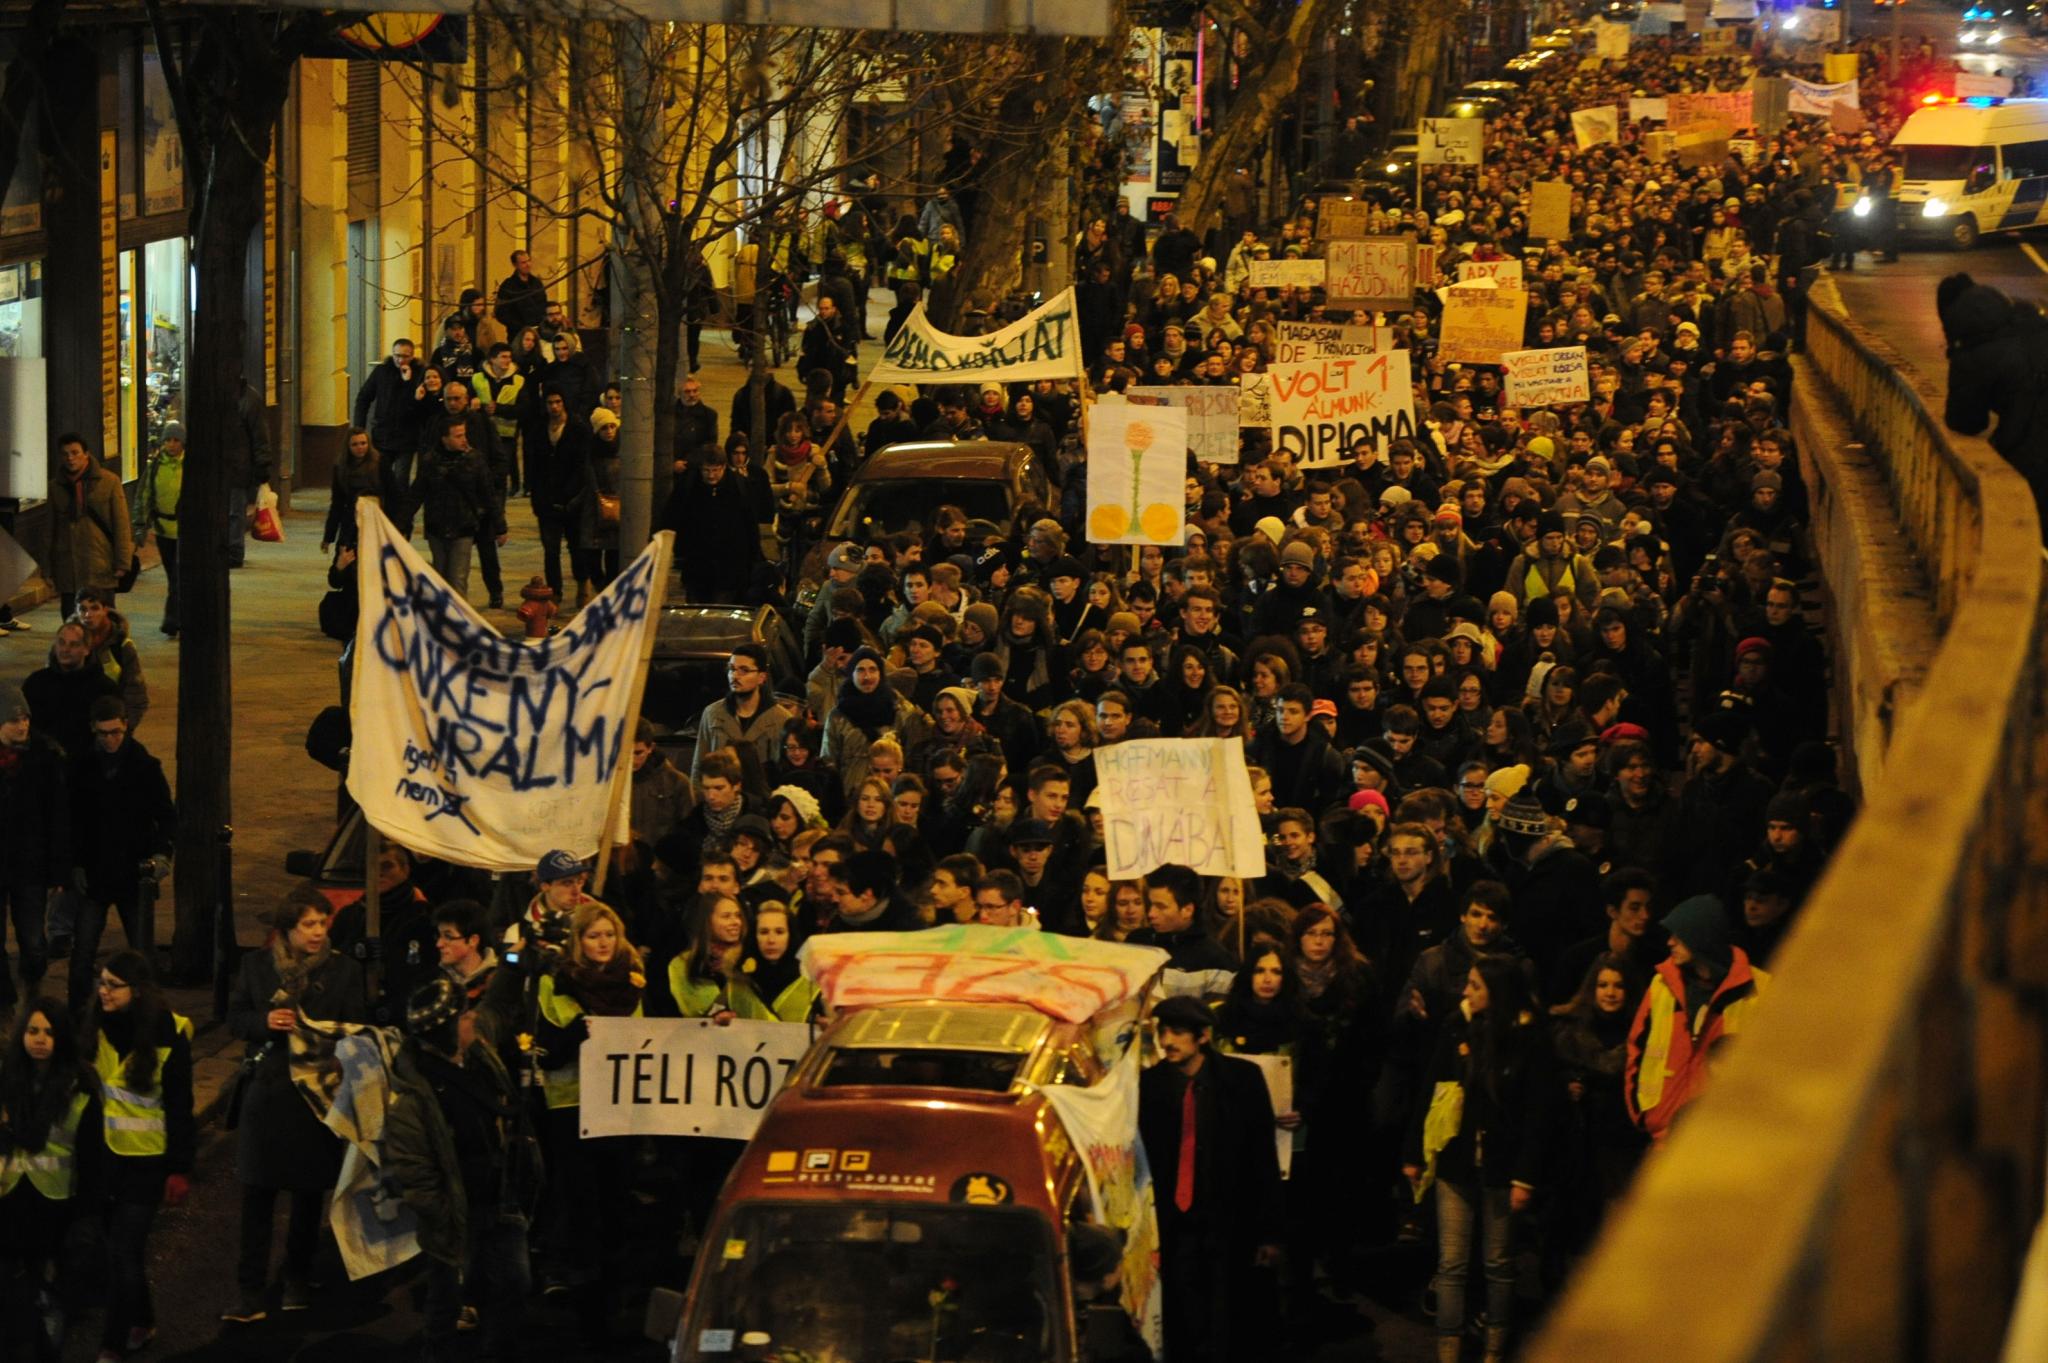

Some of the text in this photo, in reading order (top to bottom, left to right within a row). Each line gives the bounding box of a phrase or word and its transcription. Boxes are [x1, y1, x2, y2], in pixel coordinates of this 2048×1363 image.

[1466, 264, 1499, 280] ADY
[1272, 360, 1356, 402] VOLT
[1279, 409, 1413, 464] DIPLOMA
[606, 1039, 694, 1105] TÉLI
